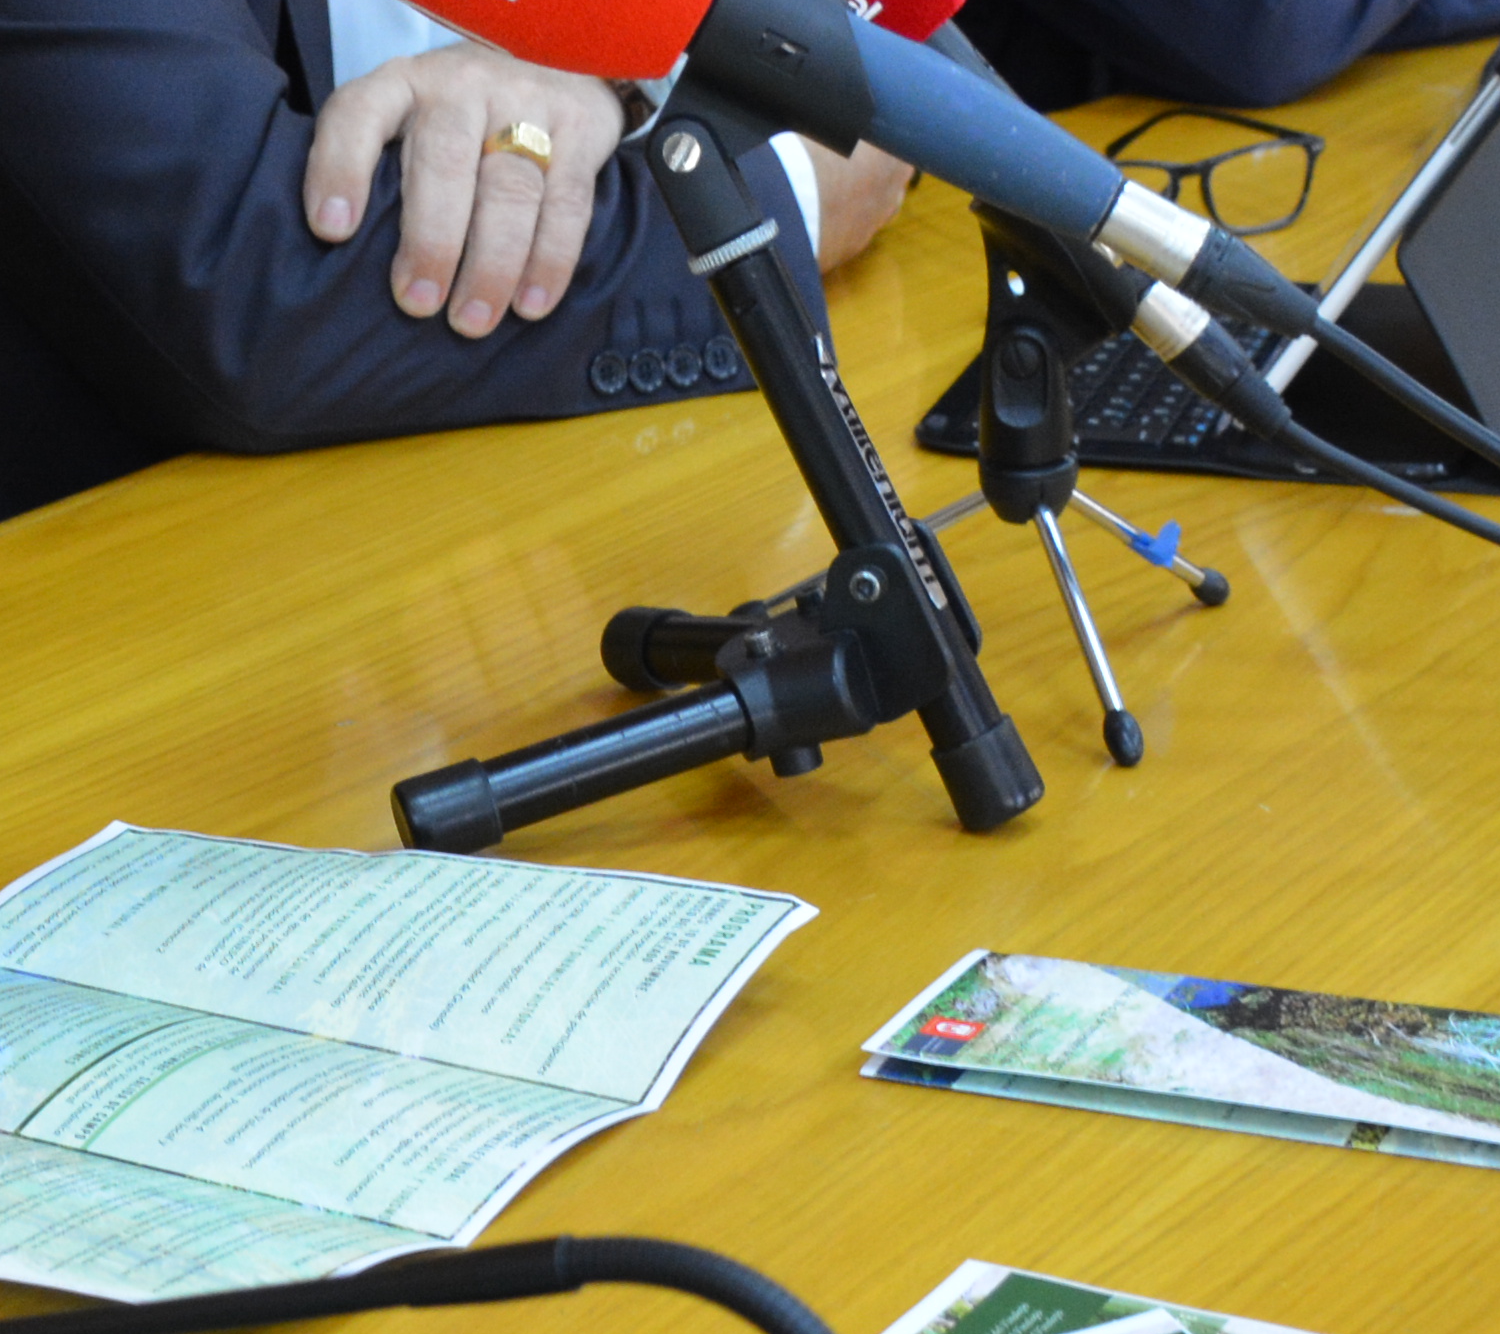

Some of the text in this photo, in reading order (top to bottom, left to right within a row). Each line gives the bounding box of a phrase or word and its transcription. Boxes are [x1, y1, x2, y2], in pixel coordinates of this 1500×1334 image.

[638, 931, 679, 963] CALZADO
[687, 901, 766, 967] PROGRAMA
[634, 950, 681, 992] NOVIEMBRE
[70, 1111, 108, 1139] CAMPO
